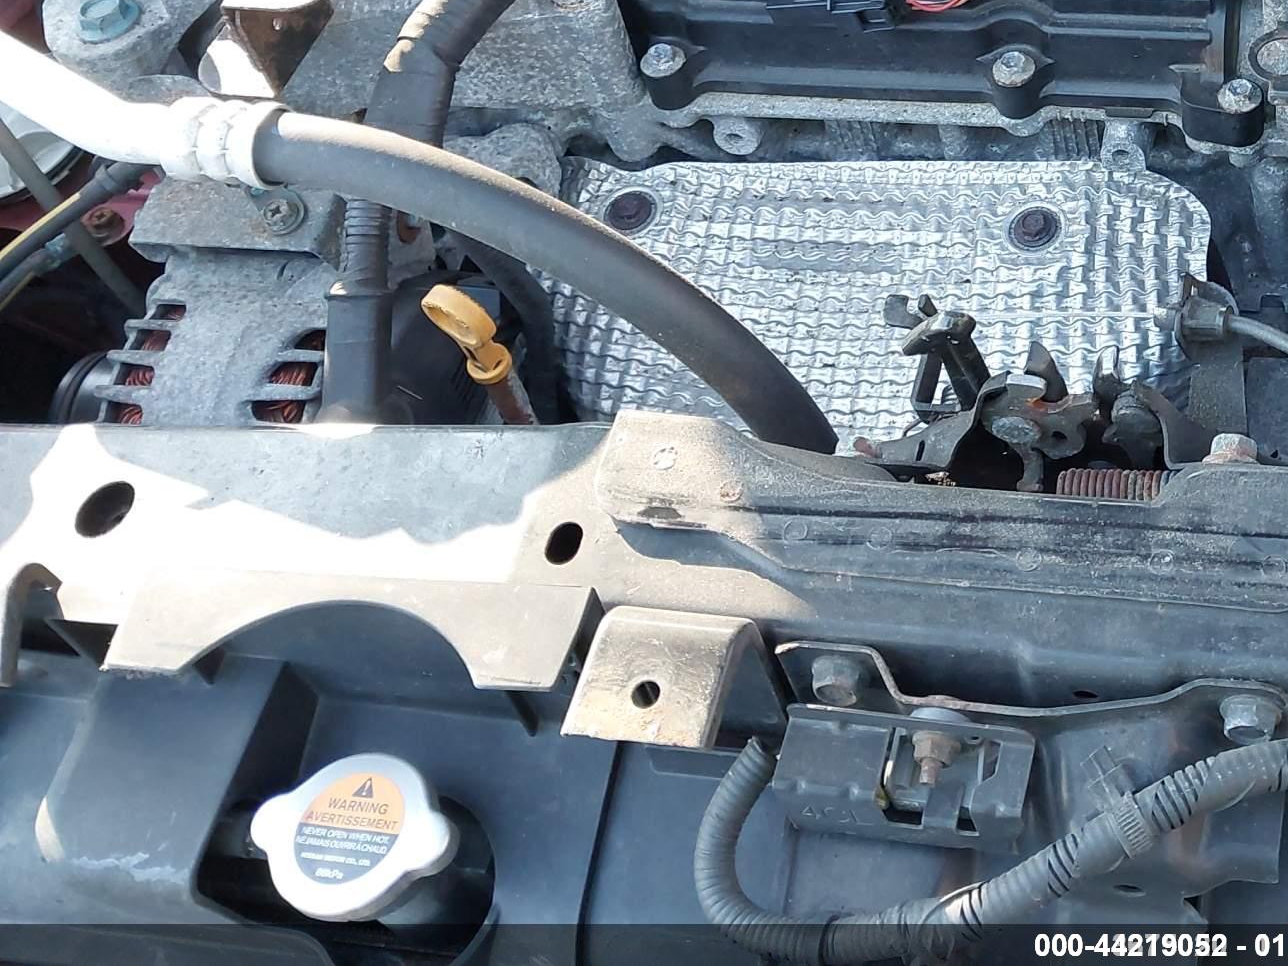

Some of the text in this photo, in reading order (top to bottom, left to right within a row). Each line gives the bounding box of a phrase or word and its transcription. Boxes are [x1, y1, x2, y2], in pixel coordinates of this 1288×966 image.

[328, 797, 390, 815] WARNING
[305, 810, 399, 830] AVERTISSEMENT
[296, 836, 308, 844] NE
[308, 838, 330, 848] JAMAIS
[302, 826, 327, 836] NEVER
[327, 829, 347, 839] OPEN
[347, 831, 372, 842] WHEN
